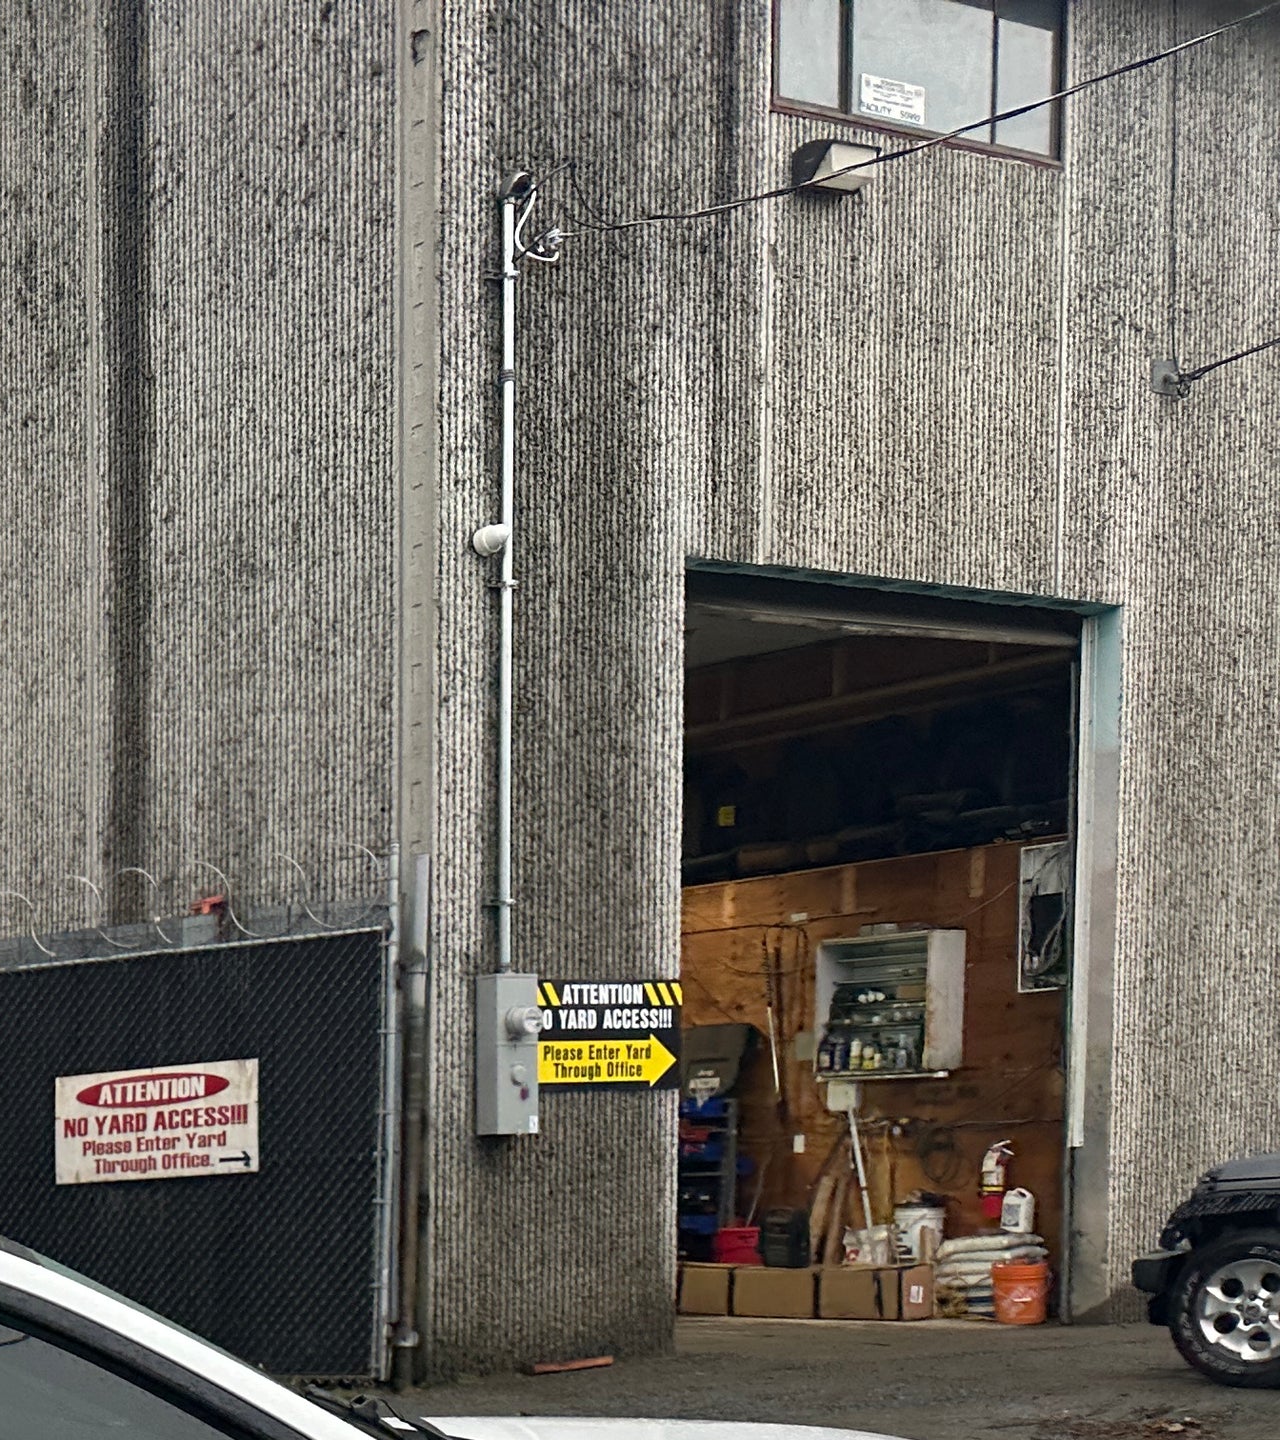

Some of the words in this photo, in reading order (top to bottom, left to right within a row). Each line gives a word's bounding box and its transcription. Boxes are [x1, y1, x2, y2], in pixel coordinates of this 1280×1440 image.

[562, 983, 644, 1005] ATTENTION
[559, 1009, 597, 1030] YARD
[603, 1008, 672, 1029] ACCESS!!!
[543, 1045, 583, 1061] Please
[588, 1045, 620, 1060] Enter
[626, 1044, 652, 1059] Yard
[553, 1062, 601, 1080] Through
[607, 1061, 643, 1077] Office
[98, 1076, 206, 1105] ATTENTION
[63, 1117, 88, 1138] NO
[93, 1113, 147, 1135] YARD
[154, 1104, 248, 1131] ACCESS!!!
[83, 1139, 132, 1156] Please
[136, 1136, 180, 1152] Enter
[186, 1131, 226, 1148] Yard
[94, 1155, 157, 1174] Through
